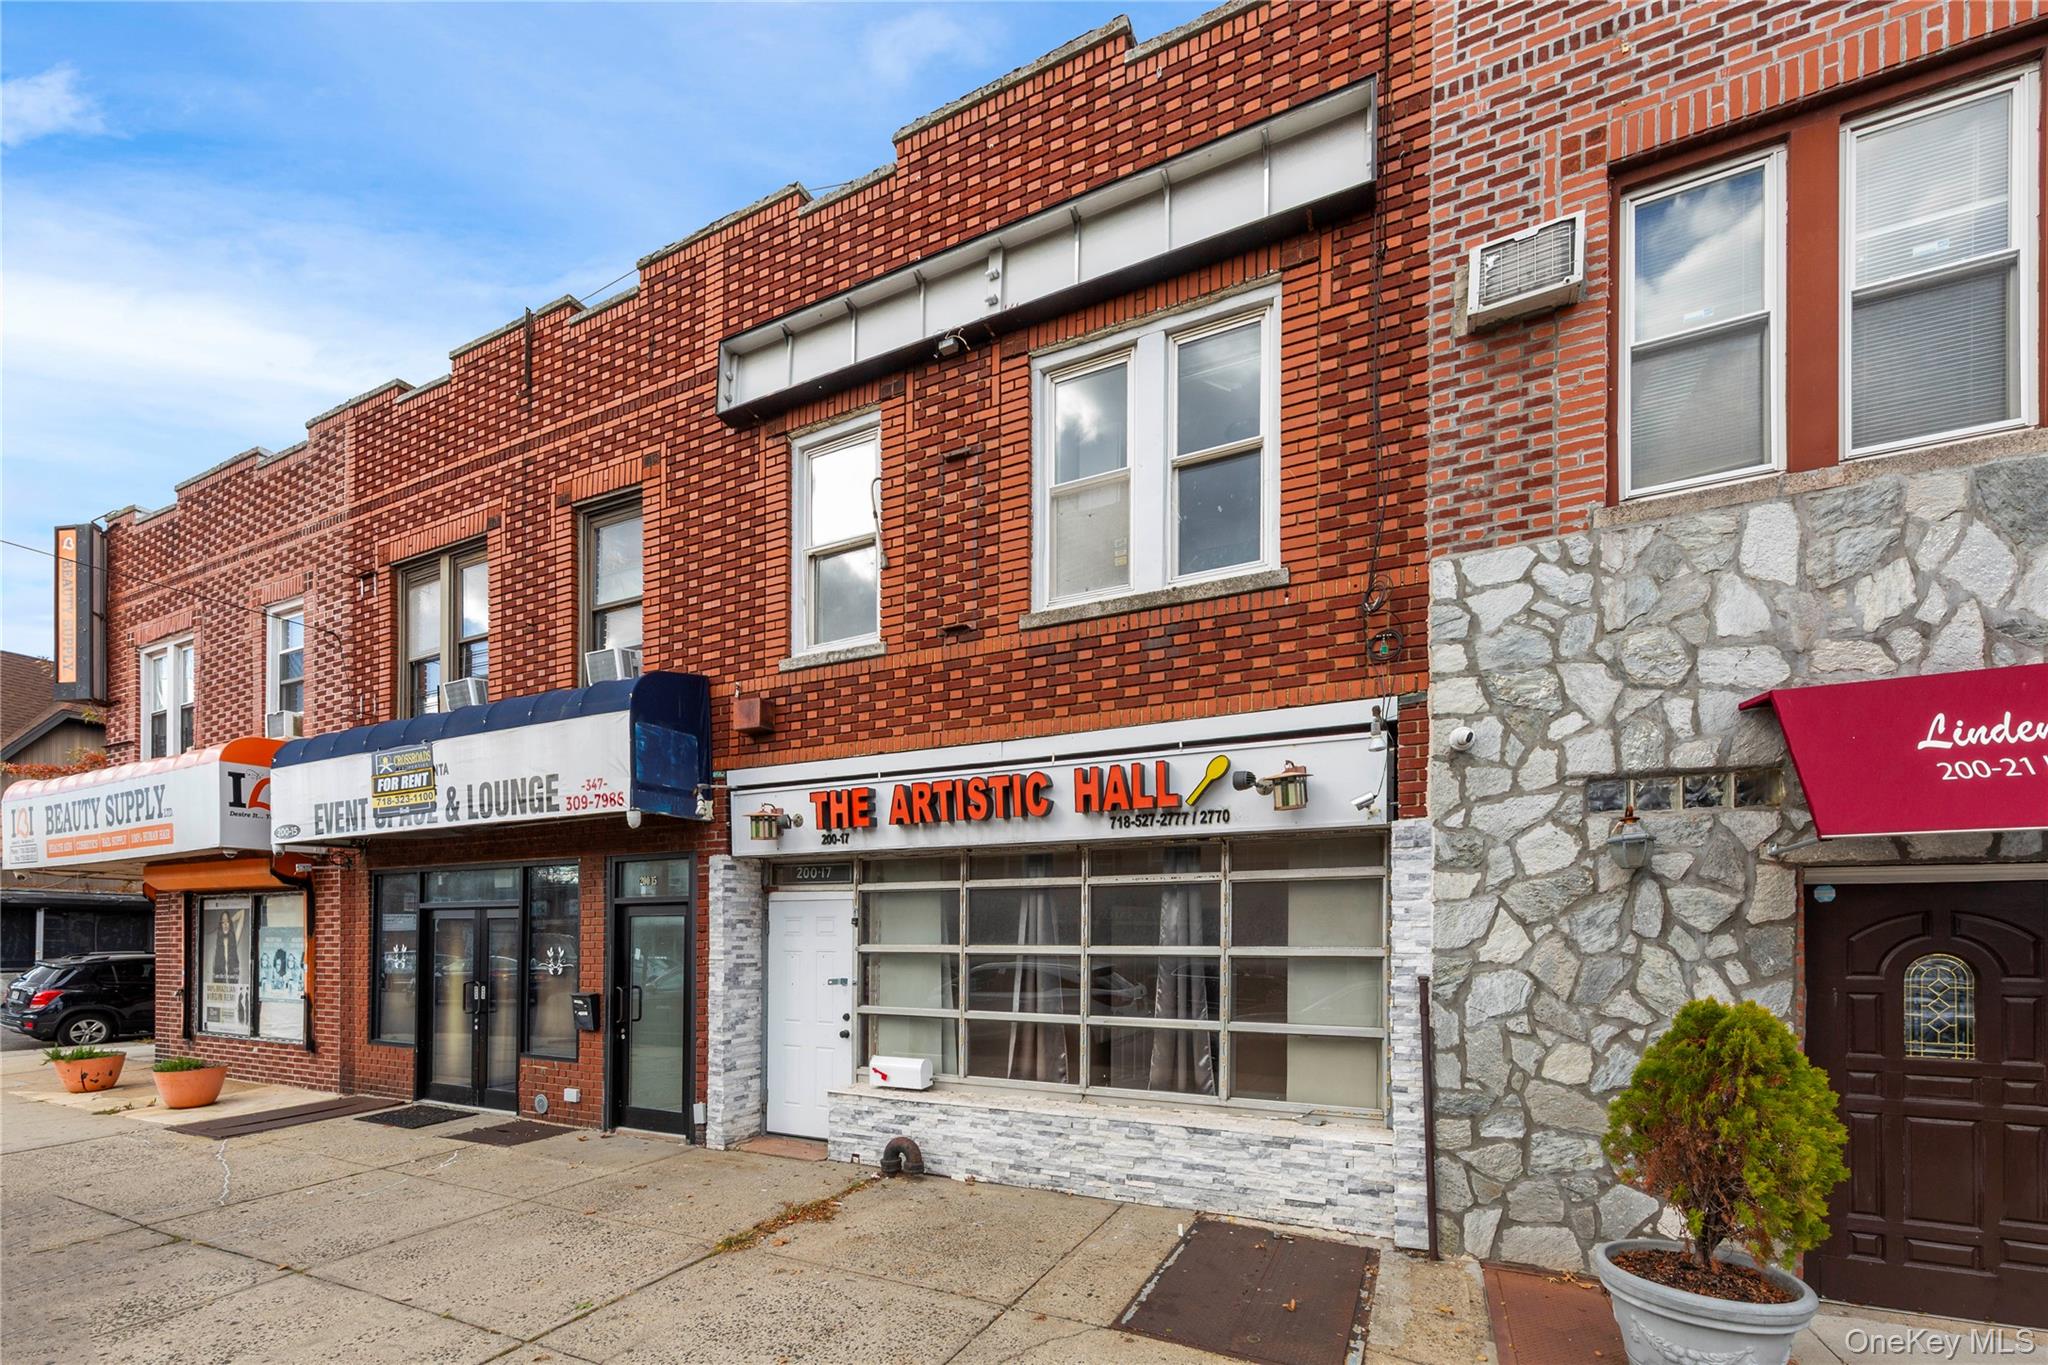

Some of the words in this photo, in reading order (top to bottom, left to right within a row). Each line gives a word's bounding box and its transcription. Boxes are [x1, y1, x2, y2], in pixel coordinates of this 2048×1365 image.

[62, 560, 73, 614] BEAUTY
[62, 621, 73, 671] SUPPLY
[1936, 756, 2036, 780] 200-21
[377, 776, 399, 792] FOR
[401, 772, 429, 790] RENT
[314, 798, 368, 836] EVENT
[446, 786, 460, 822] &
[467, 774, 560, 820] LOUNGE
[376, 792, 434, 807] 718-323-1100
[565, 792, 625, 811] 309-7986
[809, 786, 876, 831] THE
[889, 772, 1053, 826] ARTISTIC
[1074, 760, 1182, 813] HALL
[45, 797, 101, 836] BEAUTY
[105, 784, 166, 827] SUPPLY
[1110, 812, 1189, 830] 718-527-2777
[1200, 809, 1230, 825] 2770
[821, 832, 849, 845] 200-17
